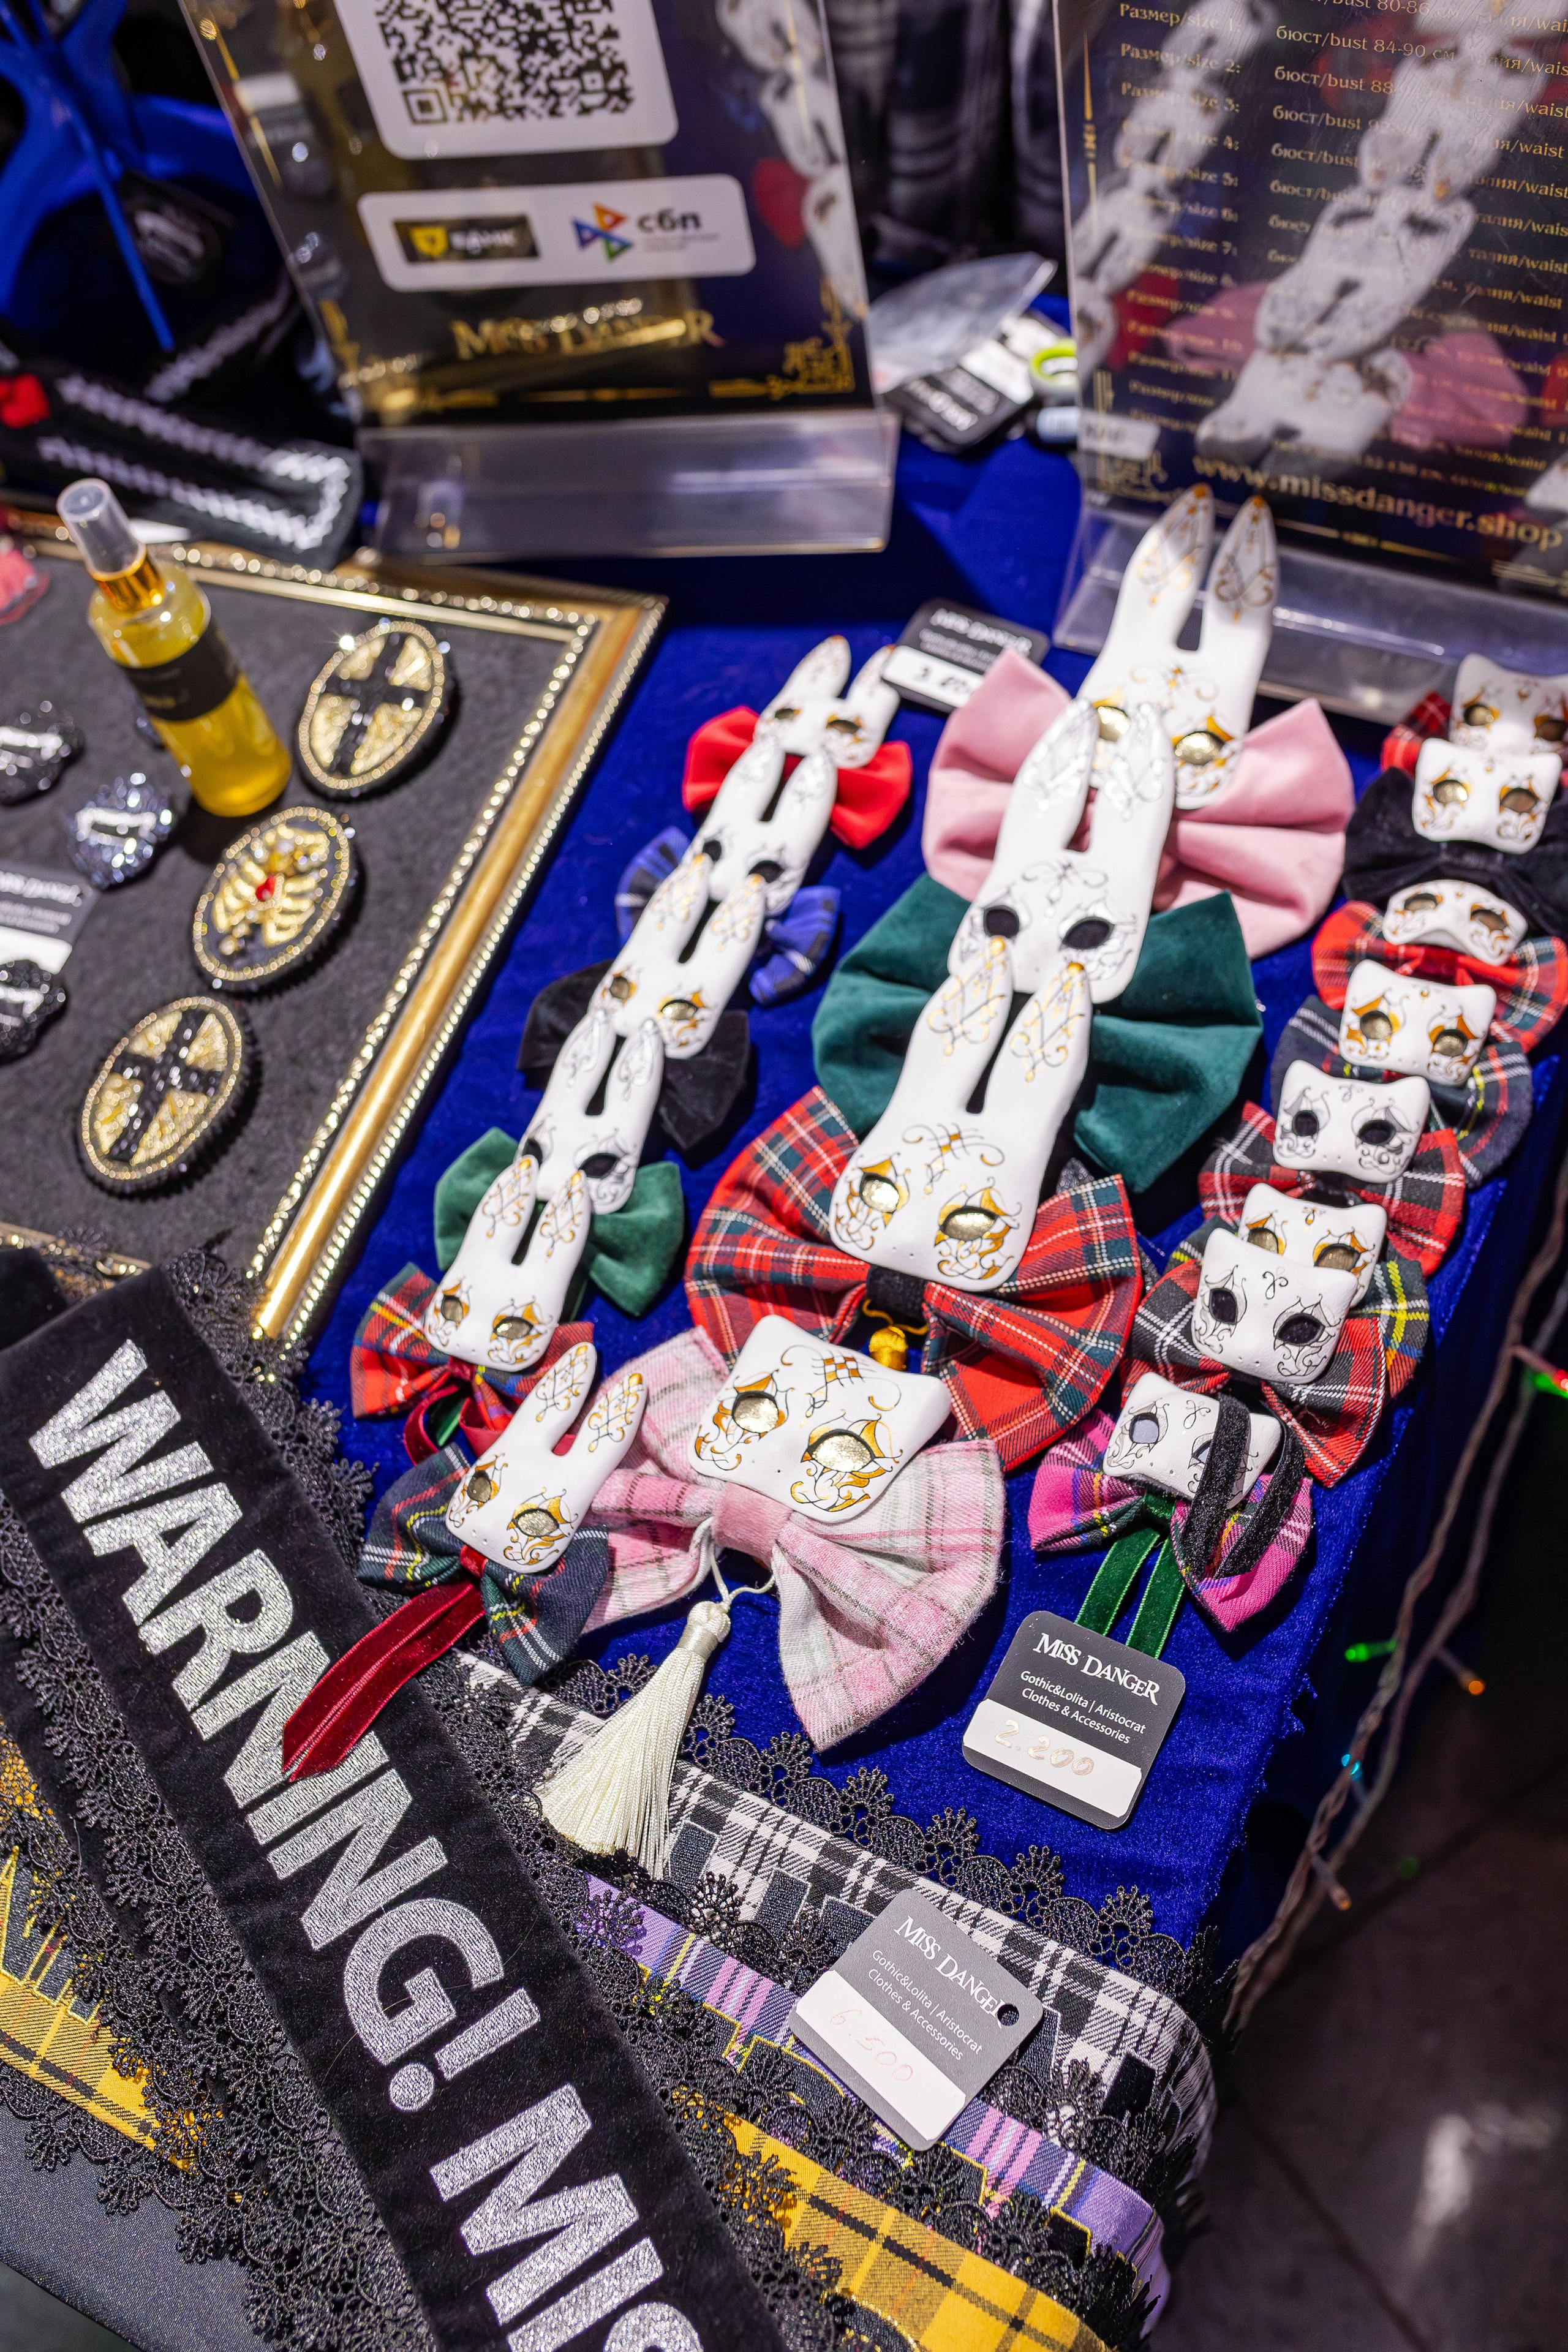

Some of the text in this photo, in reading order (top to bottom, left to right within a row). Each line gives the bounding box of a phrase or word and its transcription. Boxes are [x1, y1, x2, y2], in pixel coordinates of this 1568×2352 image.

[1276, 25, 1368, 50] бюст/bust
[1374, 39, 1426, 58] 84-90
[1274, 66, 1365, 91] бюст/bust
[1272, 105, 1361, 130] бюст/bust
[1033, 1632, 1160, 1706] MISS DANGER
[28, 1339, 540, 2113] WARNING!
[1020, 1670, 1089, 1708] Gothic&Lolita
[1095, 1703, 1146, 1735] Aristocrat
[1021, 1687, 1131, 1744] Clothes & Accessories
[994, 1719, 1095, 1776] 2.200
[893, 1915, 942, 1961] MISS
[867, 1968, 963, 2061] Clothes & Accessories
[872, 1950, 932, 2010] Gothic&Lolita
[933, 2009, 983, 2056] Aristocrat
[829, 2008, 914, 2082] 6.500
